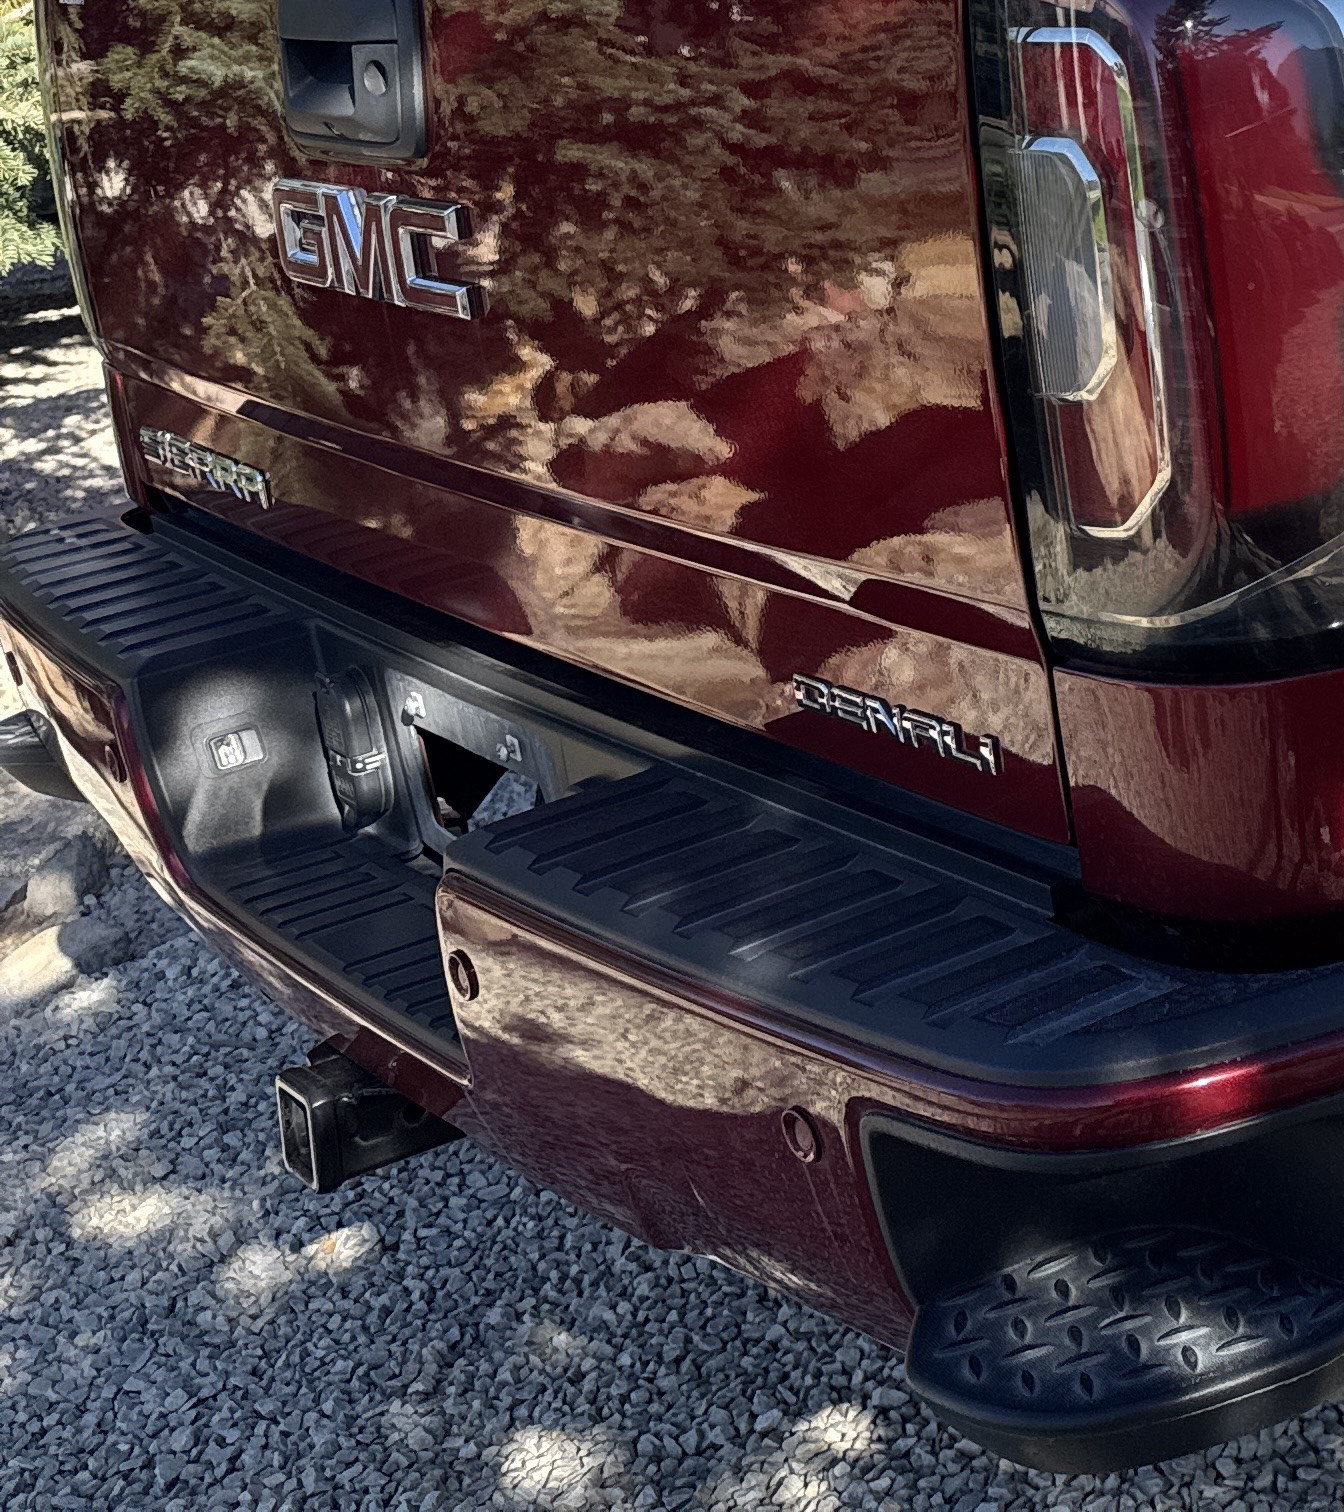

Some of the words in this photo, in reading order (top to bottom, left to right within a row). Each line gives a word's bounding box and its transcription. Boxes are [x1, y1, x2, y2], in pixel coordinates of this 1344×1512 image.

[272, 178, 482, 320] GMC
[139, 425, 275, 511] SIERRA
[792, 673, 1002, 776] DENALI
